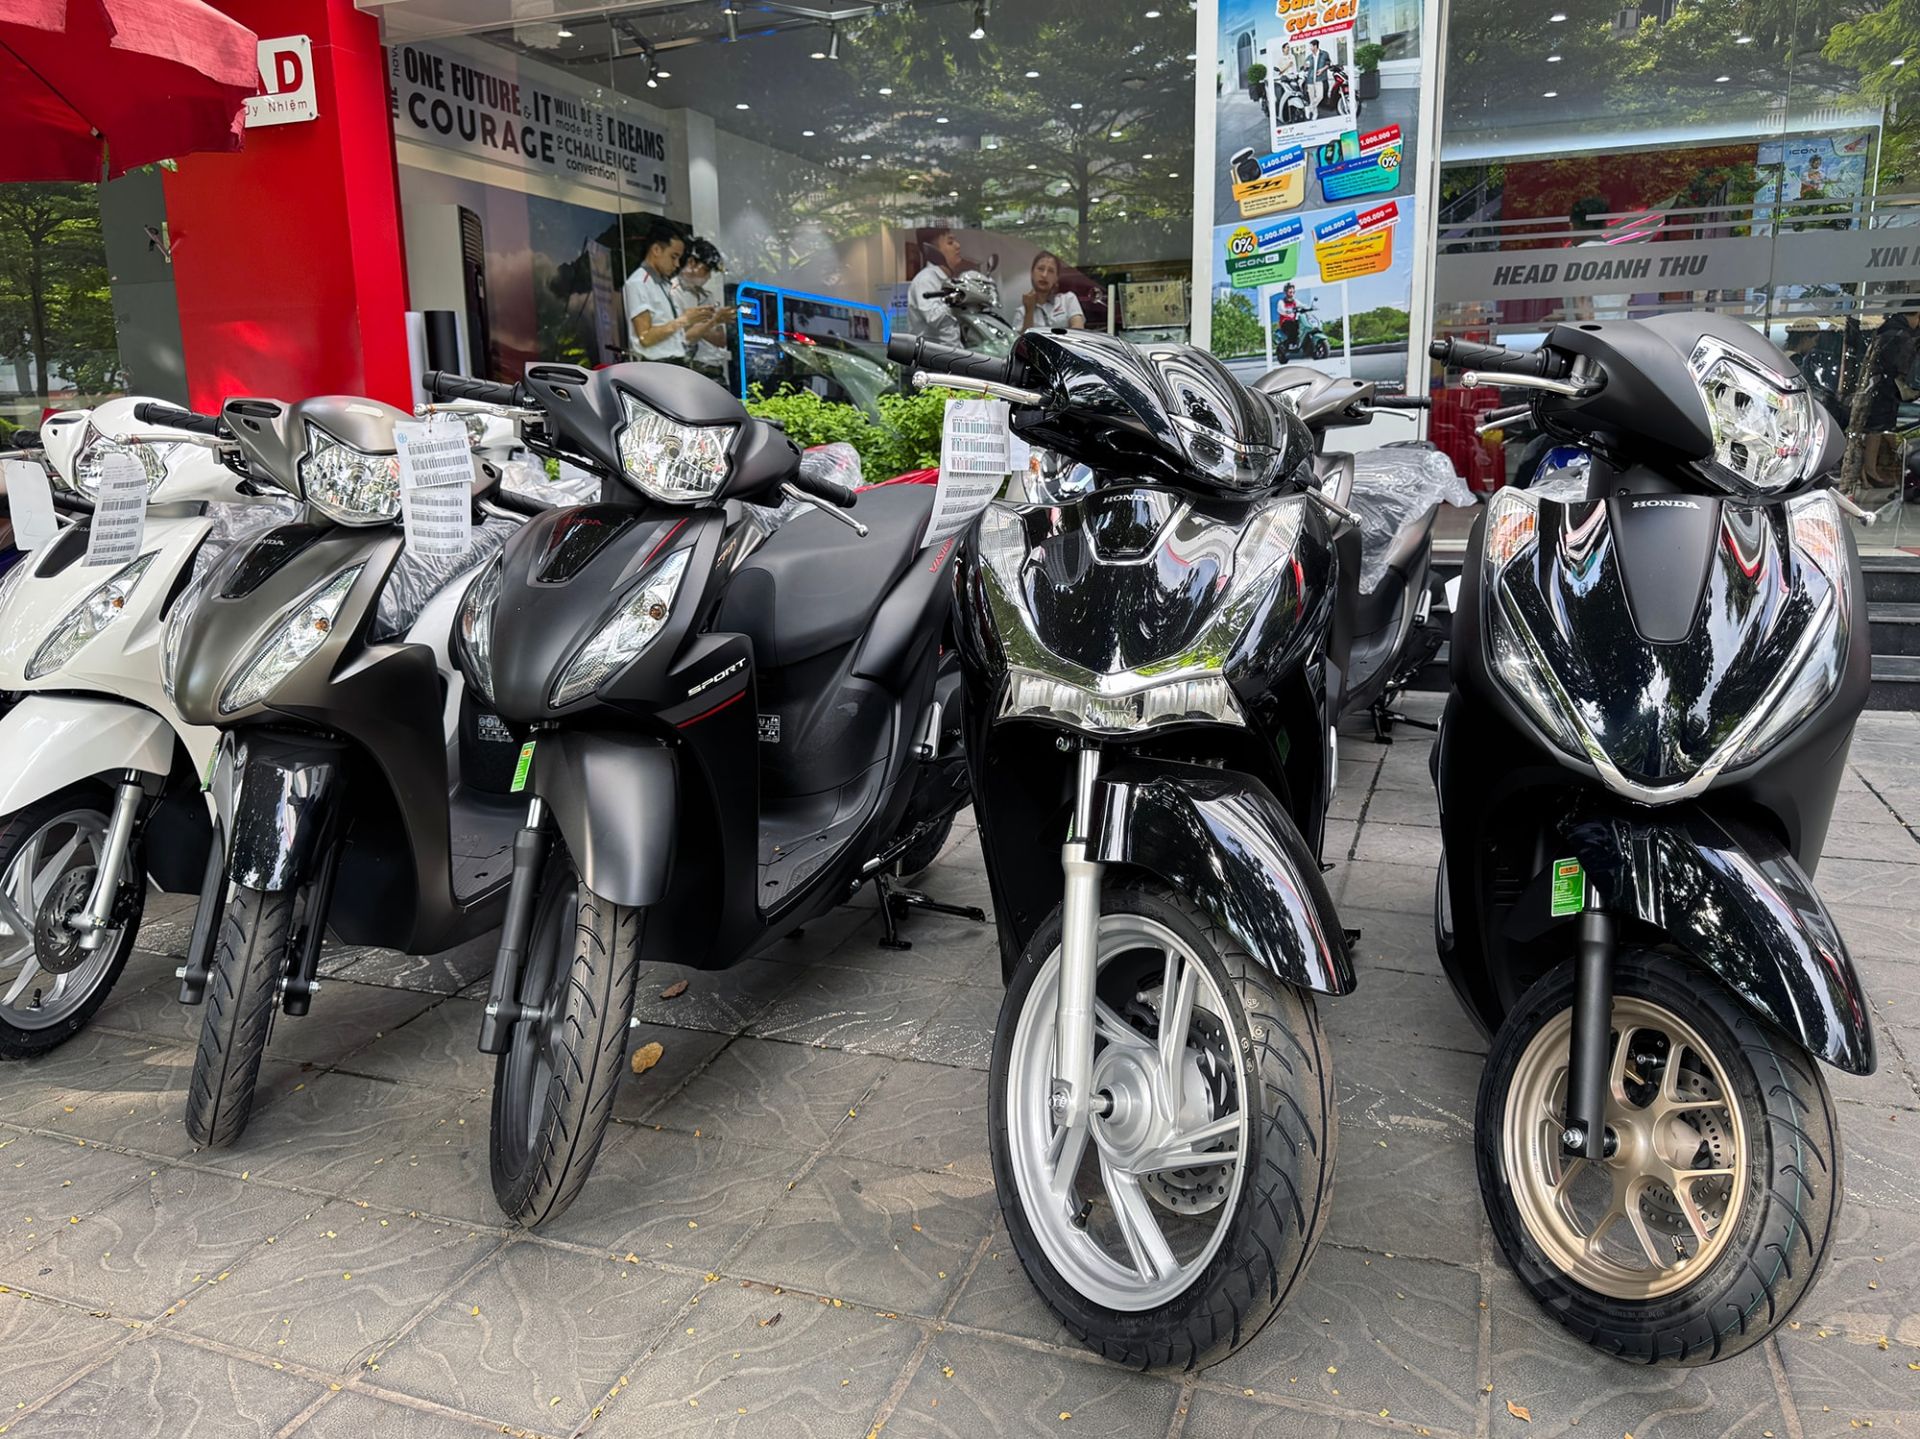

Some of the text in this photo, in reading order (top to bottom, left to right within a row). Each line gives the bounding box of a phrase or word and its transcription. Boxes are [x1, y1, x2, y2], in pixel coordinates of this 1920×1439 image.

[403, 46, 522, 117] ONE FUTURE
[533, 90, 556, 126] IT
[553, 97, 593, 126] WILL BE
[407, 91, 556, 165] COURAGE
[555, 118, 582, 135] made
[606, 116, 665, 162] DREAMS
[564, 137, 638, 174] CHALLENGE
[1381, 155, 1397, 168] 0%
[566, 157, 617, 182] convention
[1232, 237, 1253, 254] 0%
[1865, 246, 1909, 268] XIN
[1235, 257, 1265, 269] ICON
[1492, 254, 1709, 286] HEAD DOANH THU
[1102, 494, 1156, 504] HONDA
[1632, 499, 1701, 510] HONDA
[687, 657, 746, 697] SPORT
